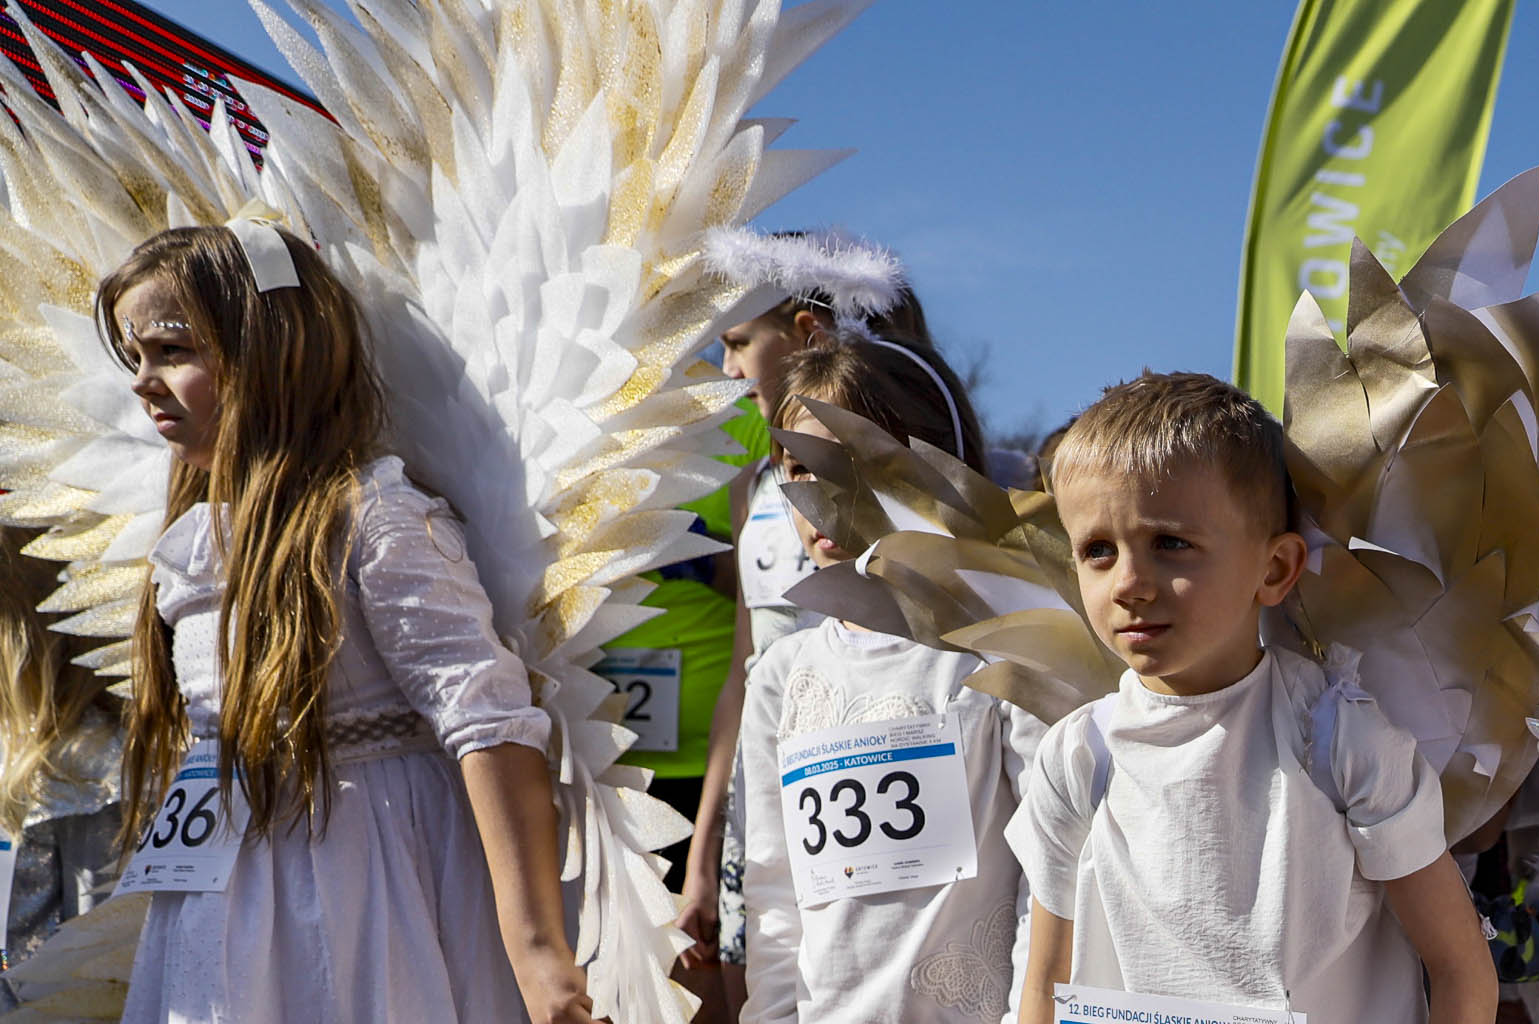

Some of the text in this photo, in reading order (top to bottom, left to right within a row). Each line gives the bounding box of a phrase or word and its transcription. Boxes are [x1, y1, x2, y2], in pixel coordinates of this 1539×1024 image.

[1298, 75, 1384, 332] OWICE
[854, 734, 887, 748] ANIOŁY
[844, 752, 893, 767] KATOWICE
[799, 771, 926, 855] 333
[1068, 1003, 1081, 1016] 12.
[1083, 1005, 1104, 1018] BIEG
[1106, 1008, 1152, 1024] FUNDACJI
